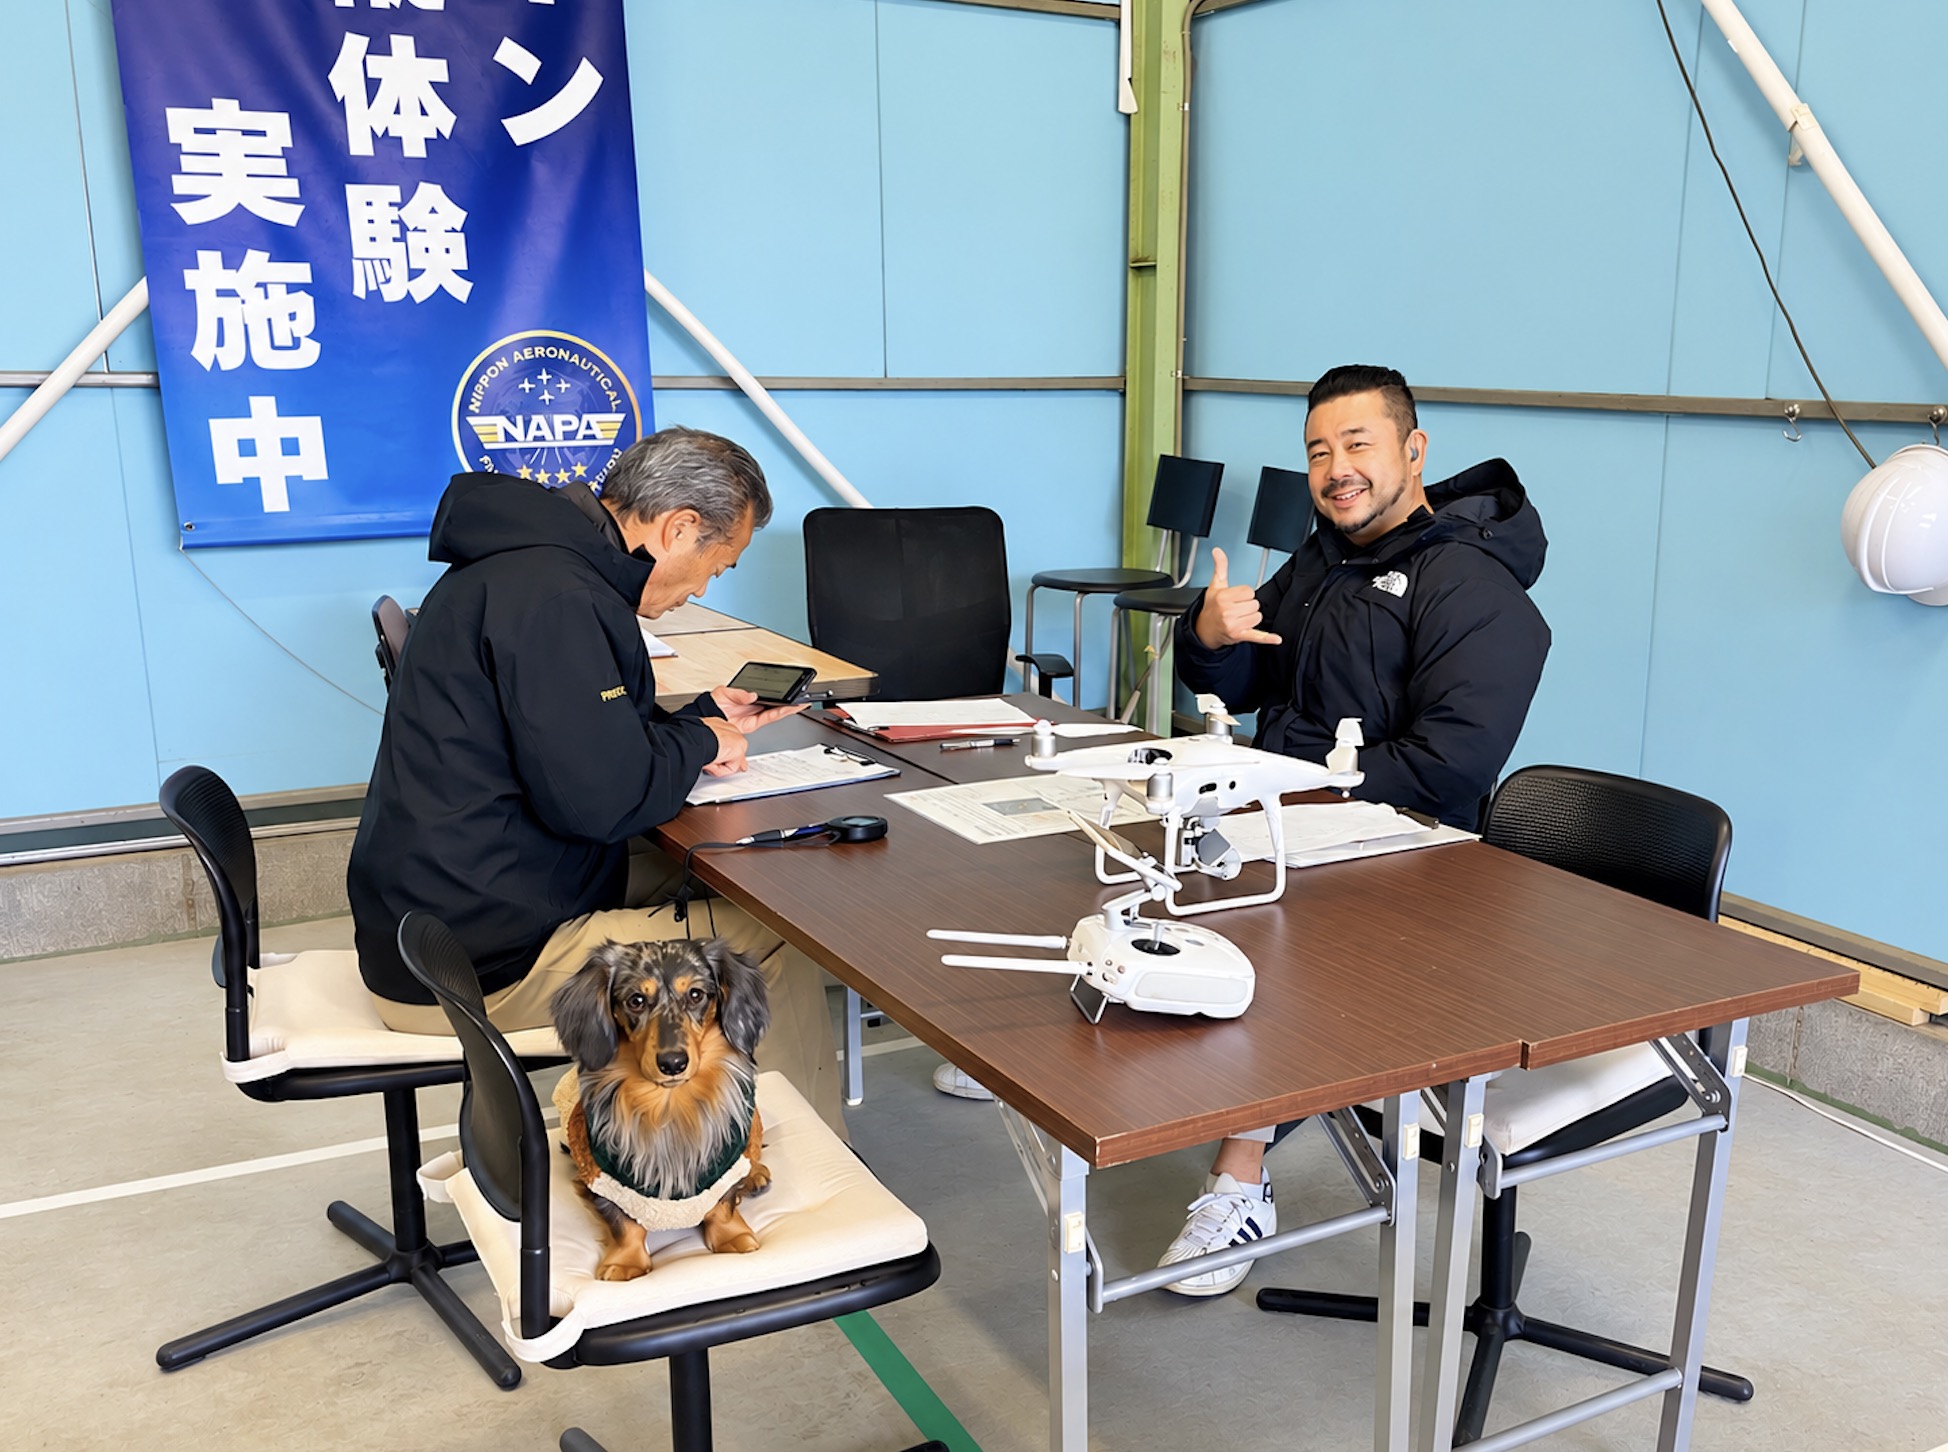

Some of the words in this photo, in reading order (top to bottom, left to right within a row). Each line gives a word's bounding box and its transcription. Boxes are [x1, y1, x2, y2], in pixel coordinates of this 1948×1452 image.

[493, 0, 604, 146] ン
[328, 0, 473, 304] 体験
[164, 97, 329, 513] 実施中
[468, 357, 509, 414] NIPPON
[512, 346, 622, 413] AERONAUTICAL
[496, 414, 604, 442] NAPA
